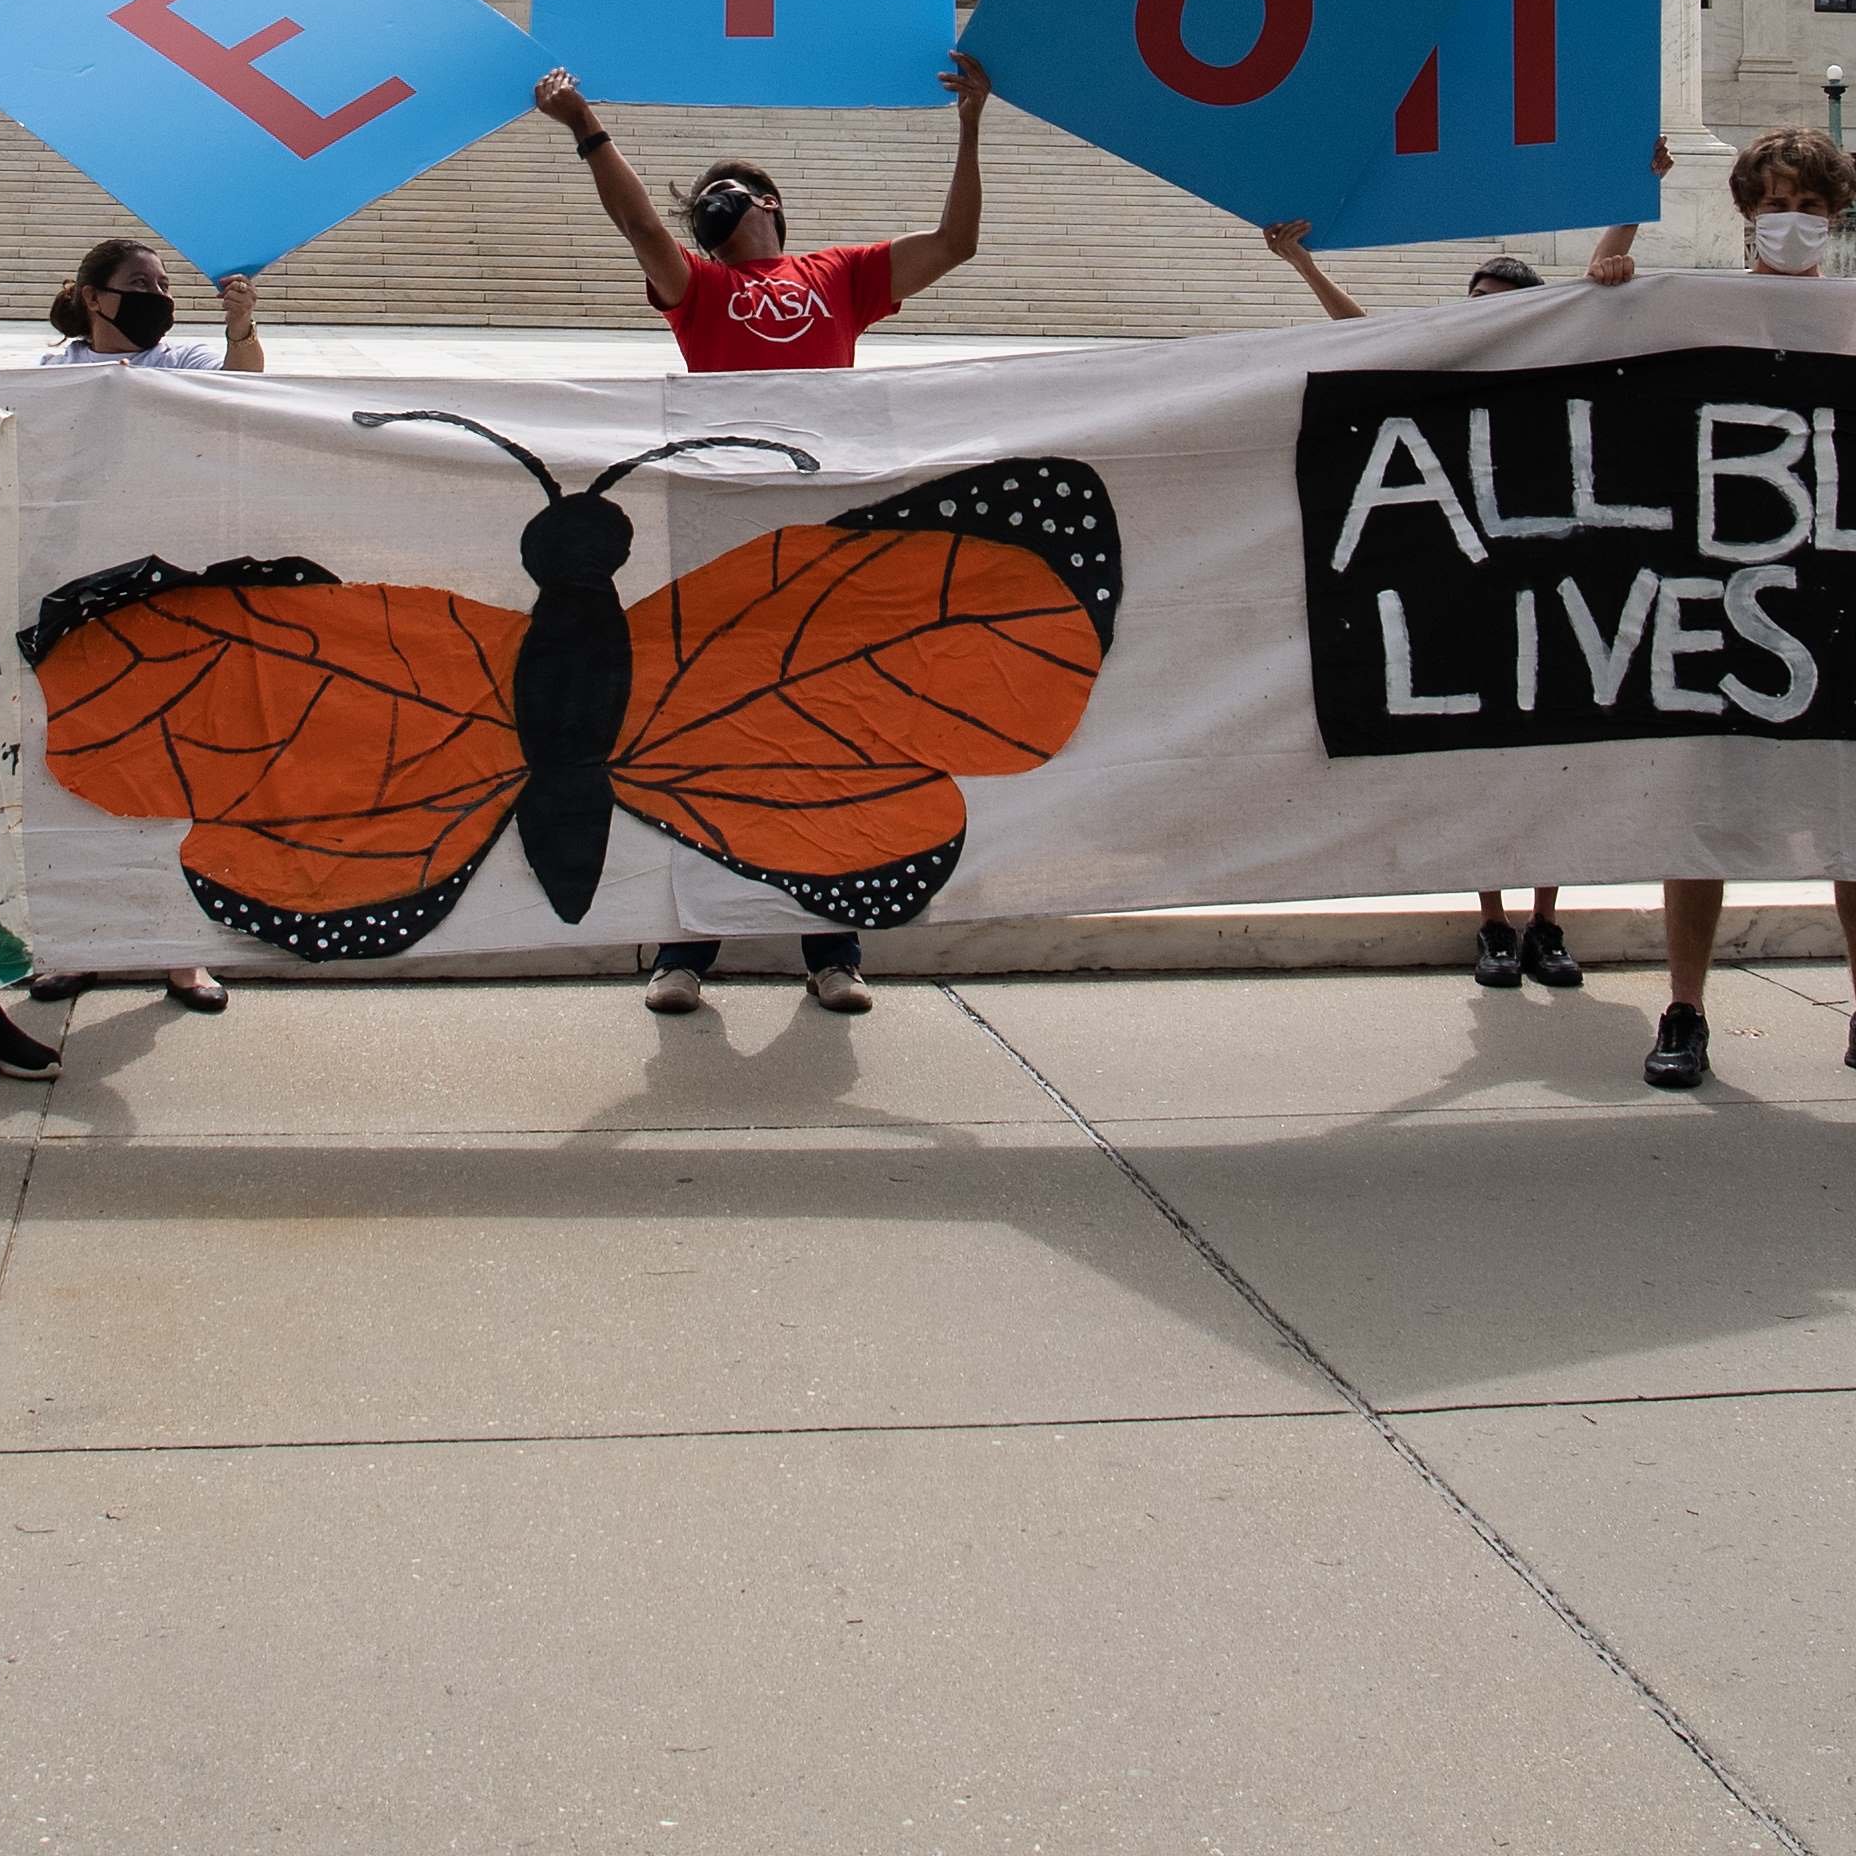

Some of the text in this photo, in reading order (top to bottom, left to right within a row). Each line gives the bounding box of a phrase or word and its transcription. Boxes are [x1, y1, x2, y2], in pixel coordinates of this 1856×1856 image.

[728, 288, 832, 321] CASA
[1331, 397, 1673, 573] ALL
[1375, 564, 1819, 723] LIVES
